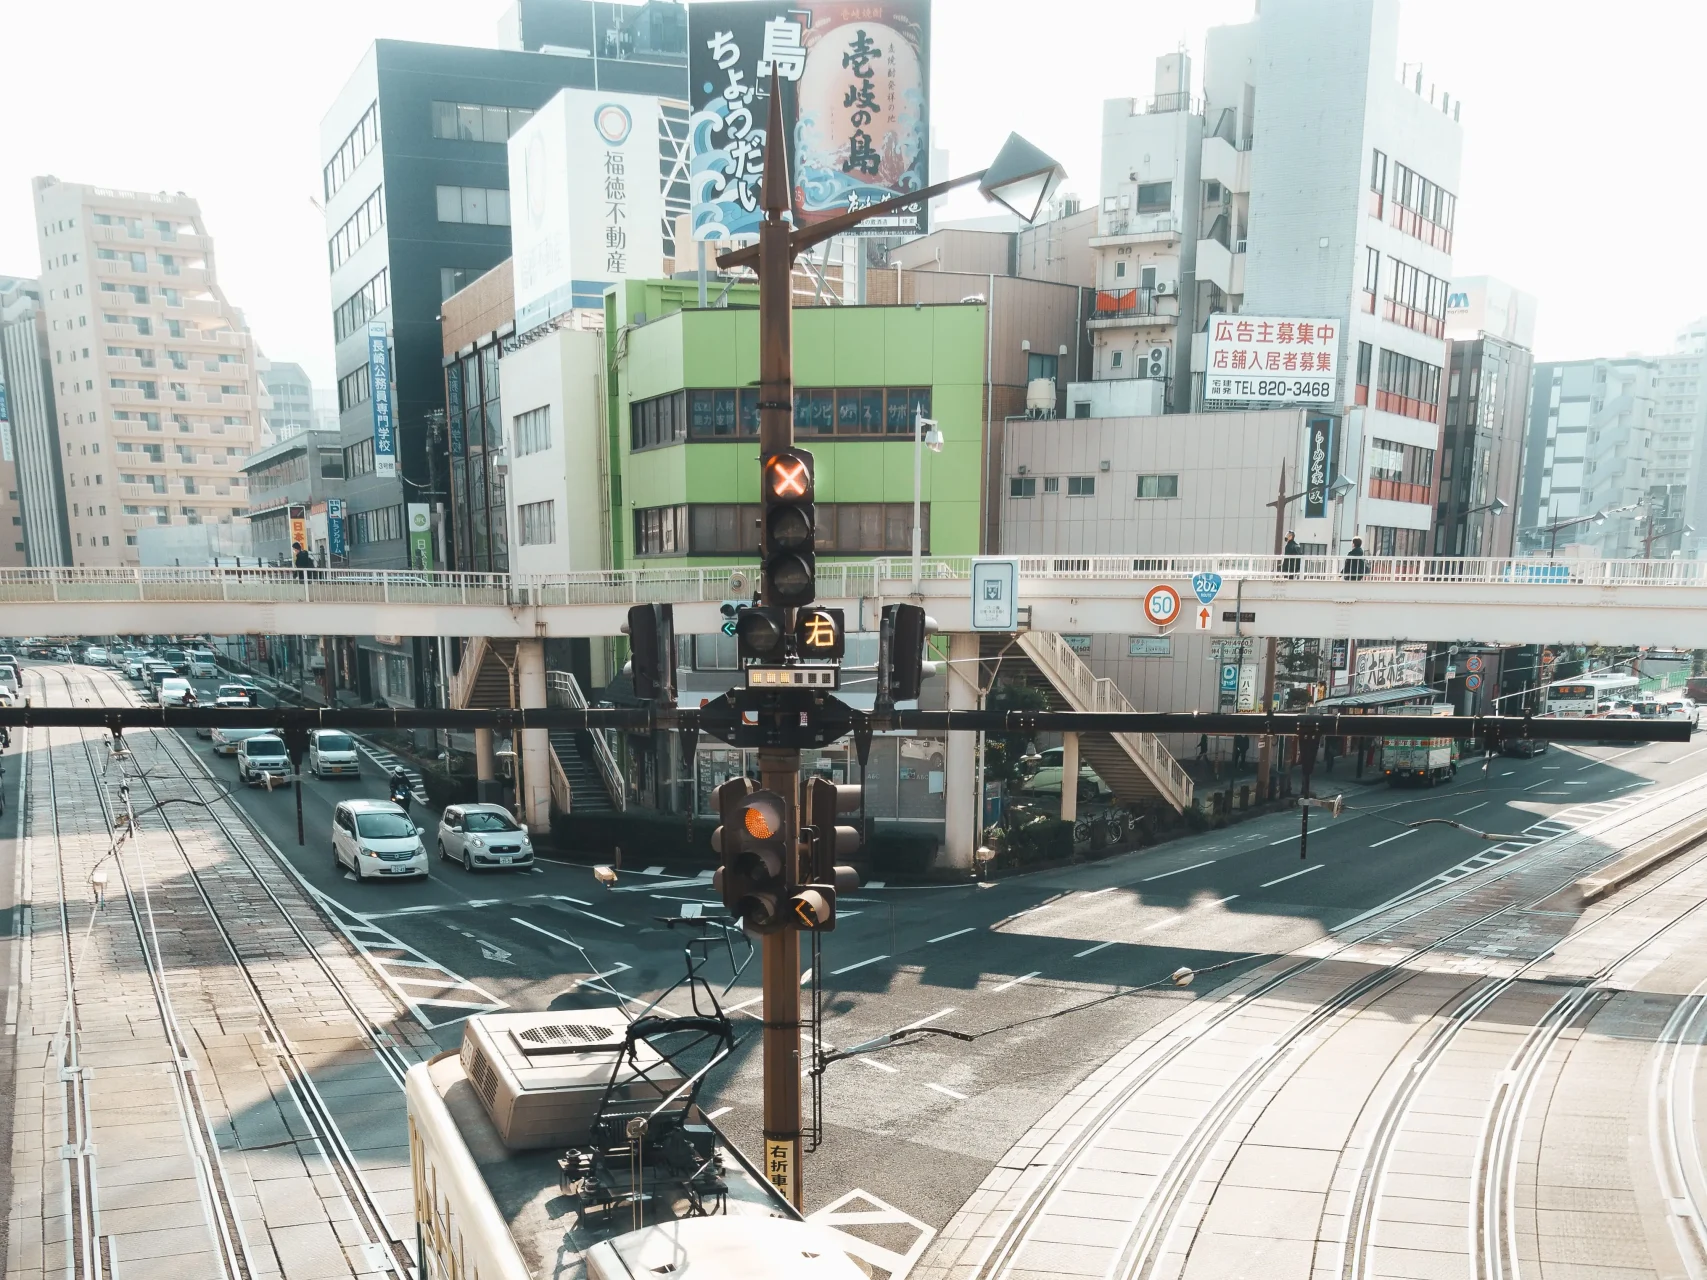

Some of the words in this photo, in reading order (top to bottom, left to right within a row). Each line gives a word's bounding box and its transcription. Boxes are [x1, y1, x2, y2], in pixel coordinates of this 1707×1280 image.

[842, 30, 882, 175] 壱岐の島
[604, 151, 627, 273] 福徳不動産
[1215, 320, 1334, 346] 広告主募集中
[1213, 349, 1331, 372] 店舗入居者募集
[372, 339, 391, 452] 長崎公務員専門学校
[1235, 381, 1256, 395] TEL
[1258, 381, 1330, 397] 820-3468
[1152, 596, 1173, 614] 50
[805, 615, 834, 647] 右
